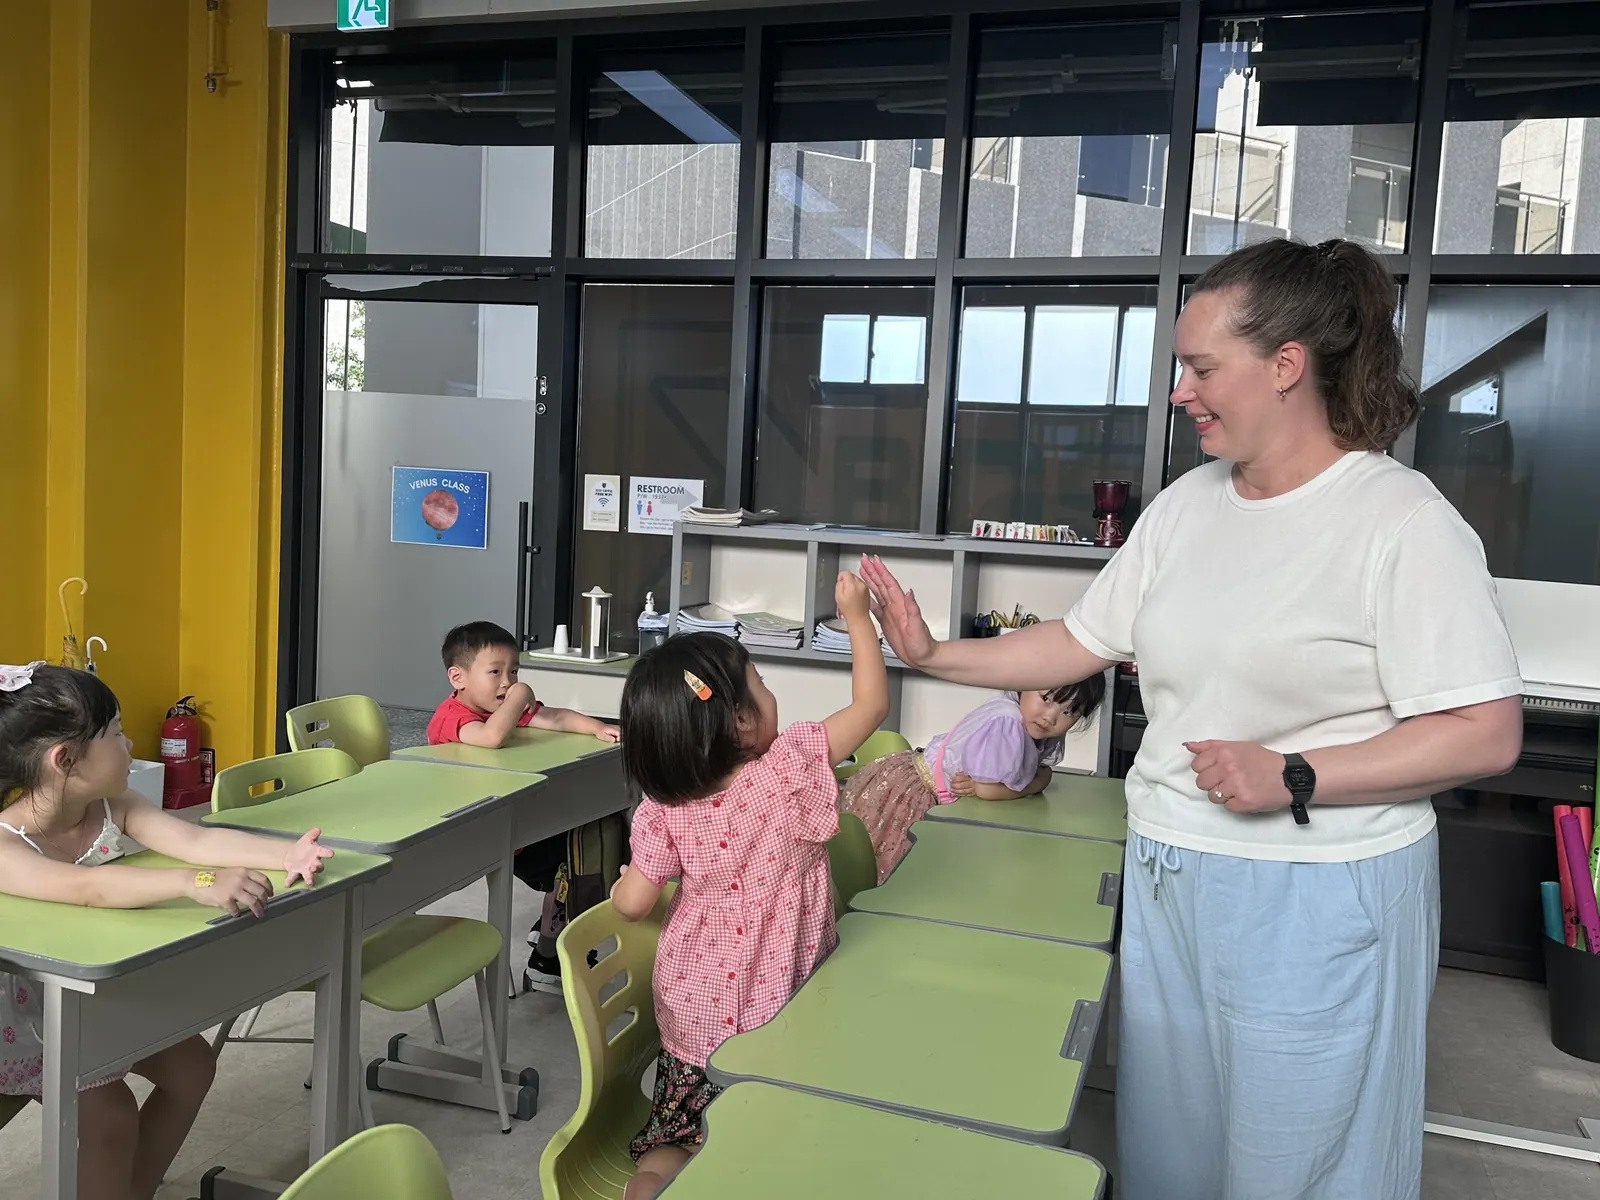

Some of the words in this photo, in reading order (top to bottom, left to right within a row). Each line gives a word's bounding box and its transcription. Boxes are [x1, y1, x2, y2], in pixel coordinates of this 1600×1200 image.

[409, 478, 438, 490] VENUS
[441, 478, 471, 494] CLASS
[637, 484, 685, 495] RESTROOM
